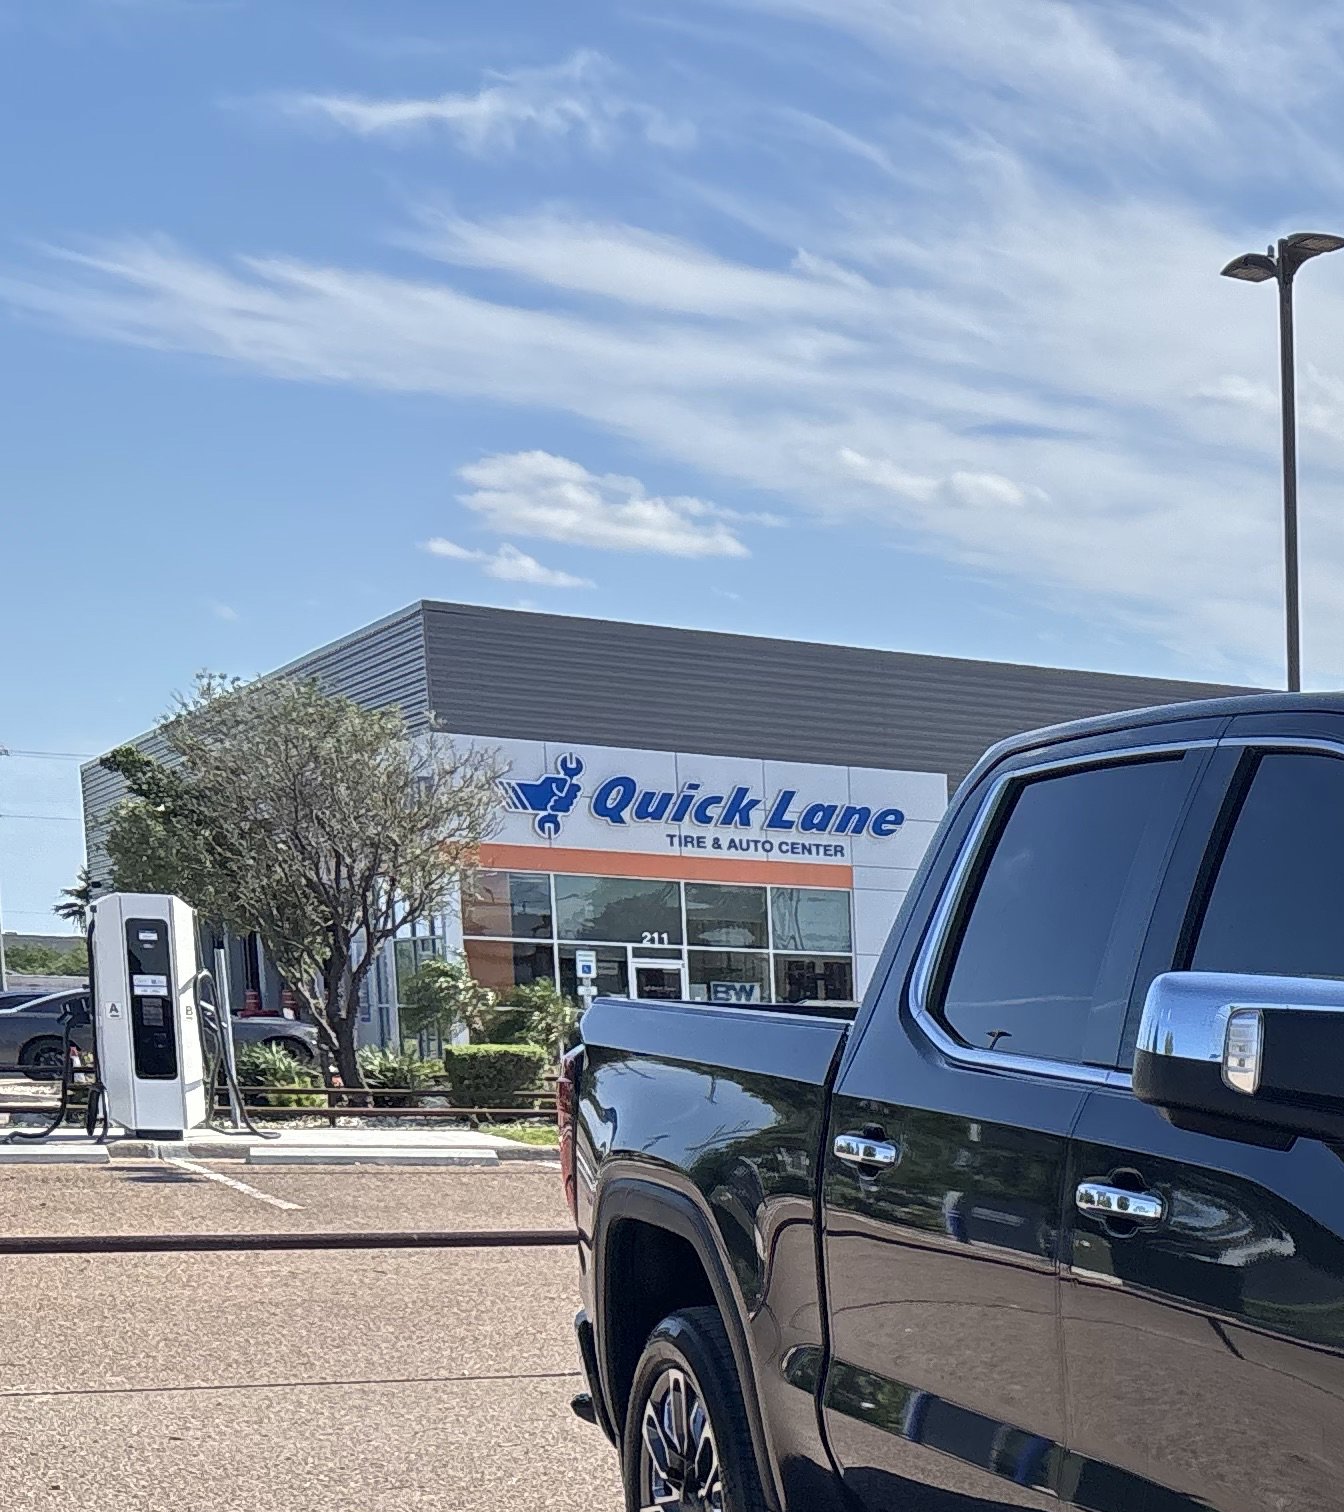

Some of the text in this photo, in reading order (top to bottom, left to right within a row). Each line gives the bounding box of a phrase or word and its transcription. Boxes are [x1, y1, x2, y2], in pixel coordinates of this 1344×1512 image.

[593, 776, 904, 837] Quick Lane
[666, 834, 845, 857] TIRE & AUTO CENTER
[641, 931, 669, 946] 211
[109, 1003, 119, 1014] A
[185, 1006, 193, 1016] B
